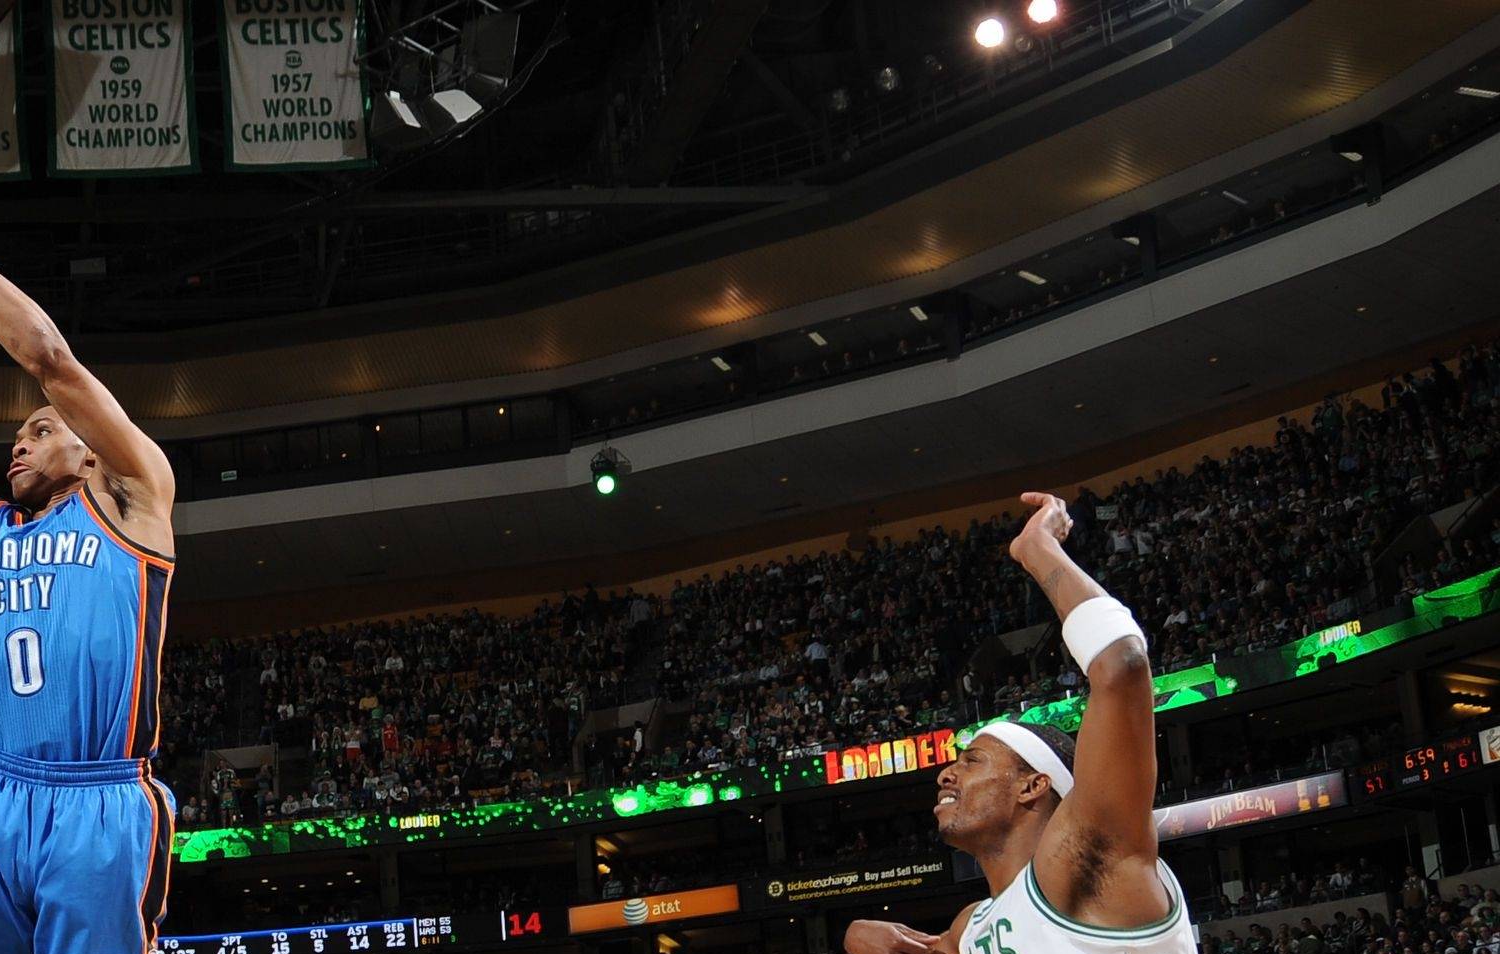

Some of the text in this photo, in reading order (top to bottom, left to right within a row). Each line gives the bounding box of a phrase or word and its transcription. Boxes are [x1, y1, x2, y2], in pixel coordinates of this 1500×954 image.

[68, 21, 171, 50] CELTICS
[241, 16, 344, 45] CELTICS
[100, 79, 142, 99] 1959
[271, 73, 312, 93] 1957
[88, 103, 158, 124] WORLD
[262, 97, 332, 118] WORLD
[66, 124, 181, 148] CHAMPIONS
[241, 121, 357, 143] CHAMPIONS
[5, 626, 45, 697] 0
[825, 728, 957, 785] LOUDER
[1458, 751, 1477, 769] 61
[1421, 768, 1430, 781] 3
[399, 814, 441, 829] LOUDER
[1206, 792, 1276, 830] JIM BEAM
[787, 874, 859, 891] ticketexchange
[864, 871, 879, 882] Buy
[881, 869, 895, 879] and
[896, 866, 911, 877] Sell
[912, 862, 943, 874] Tickets!
[652, 899, 681, 916] at&t
[419, 917, 436, 927] MEM
[419, 926, 436, 936] WAS
[509, 912, 542, 936] 14
[164, 922, 405, 950] FG 3PT TO STL AST REB
[313, 939, 324, 953] 5
[350, 935, 370, 950] 14
[386, 933, 406, 947] 22
